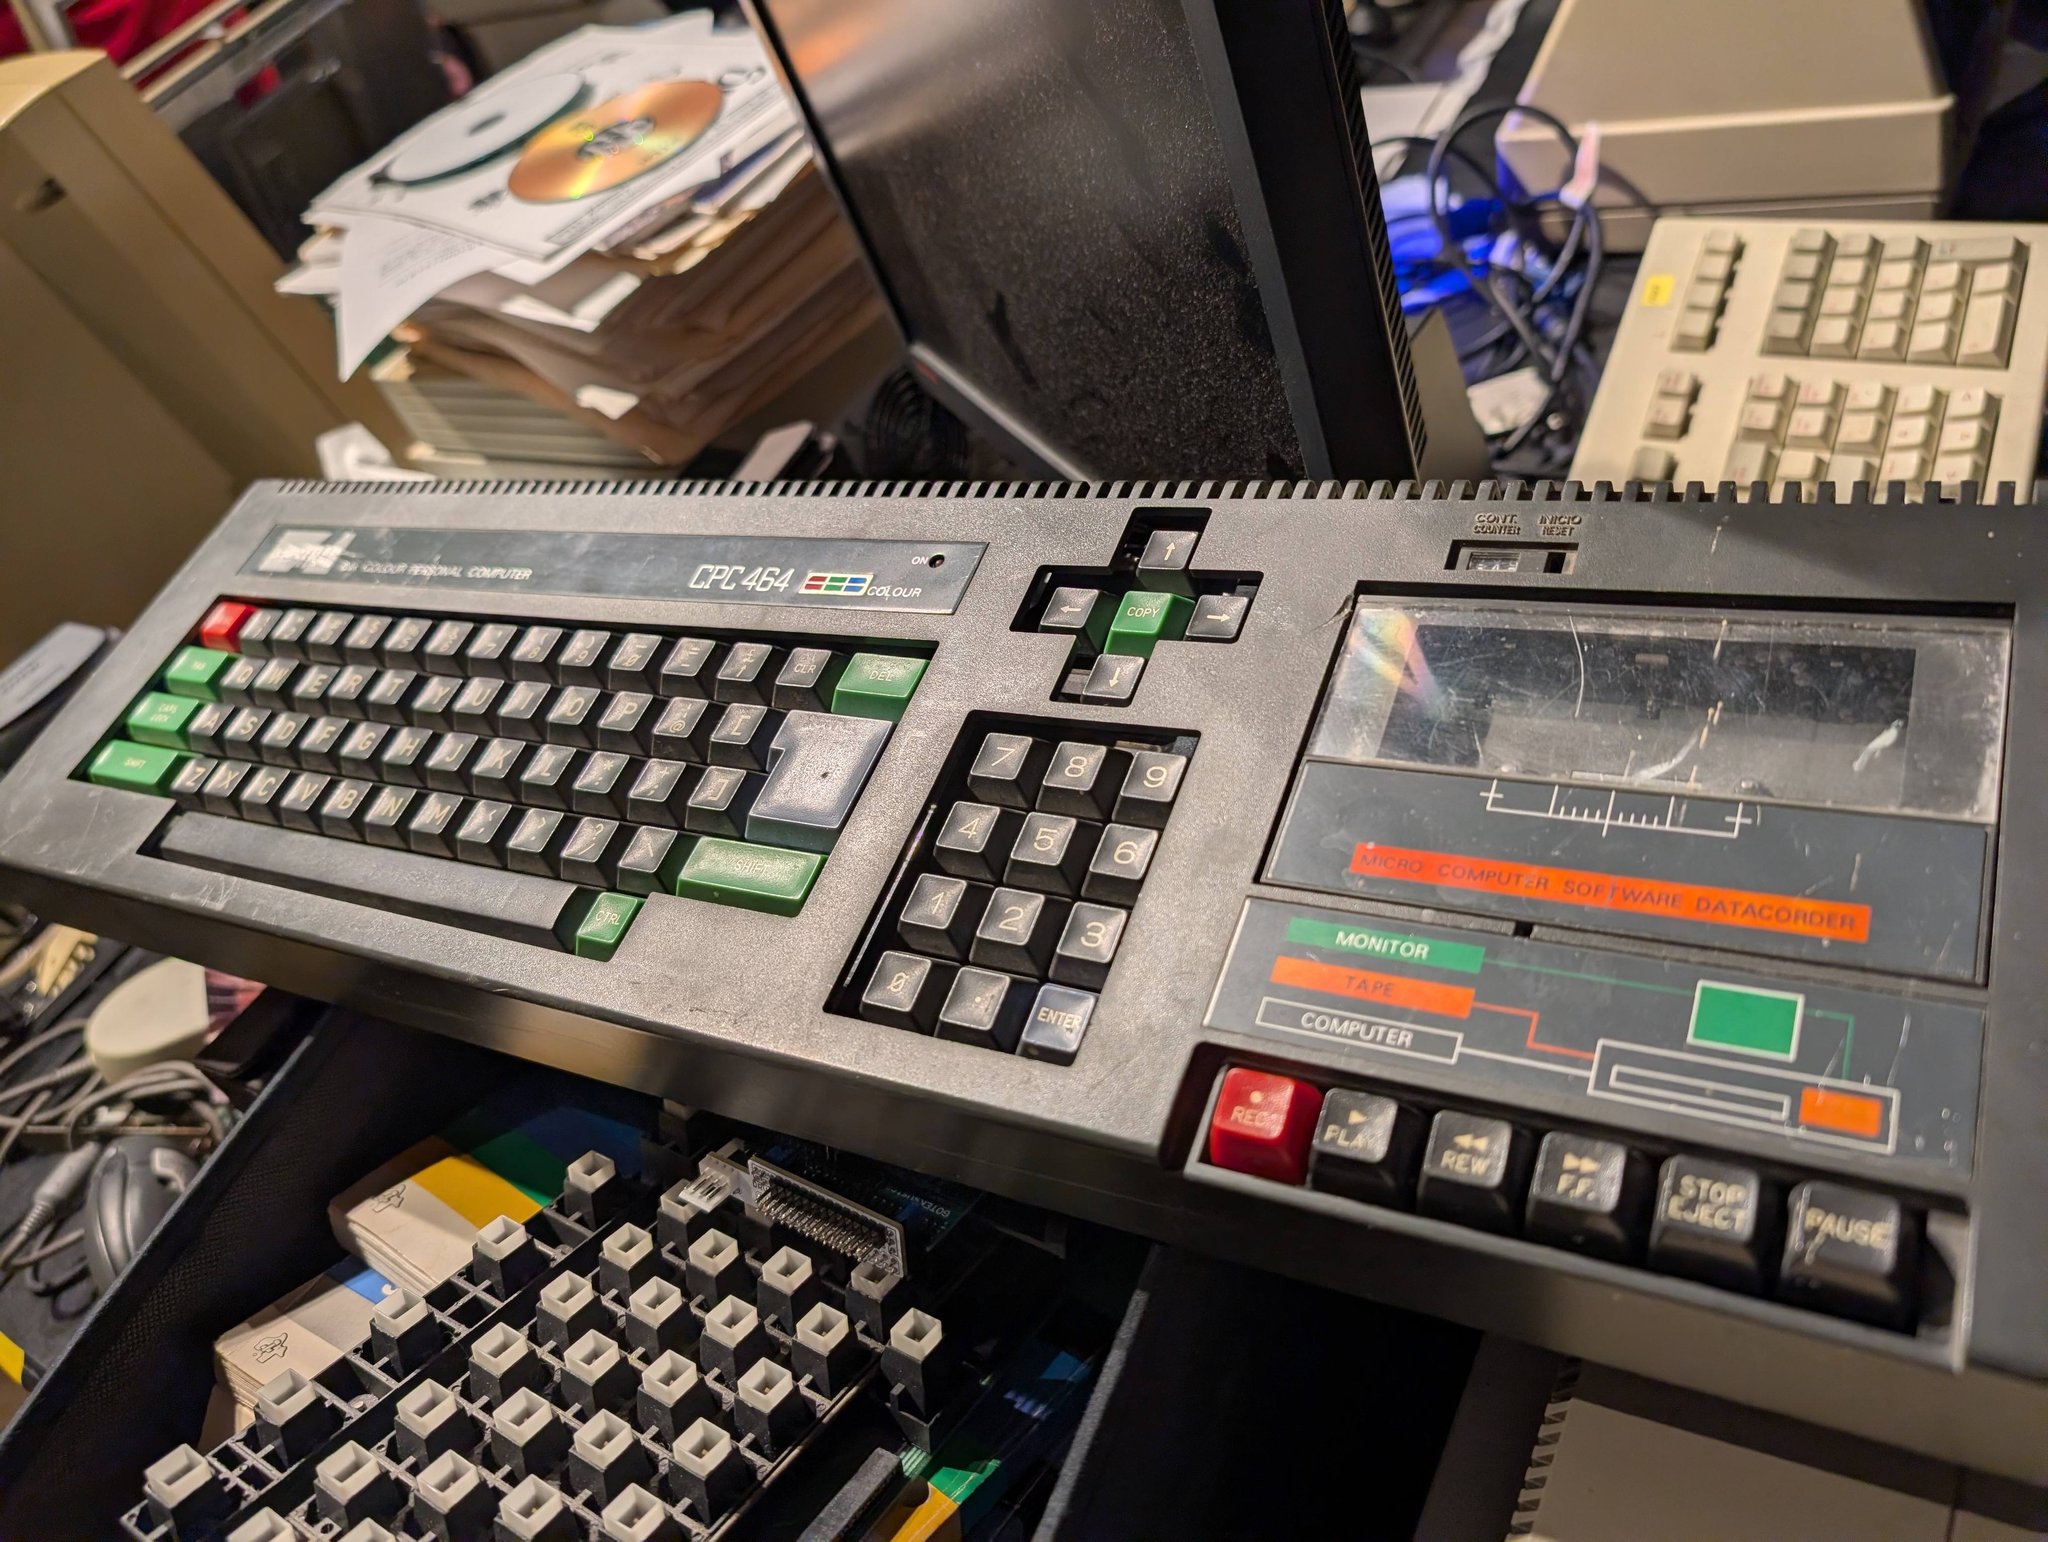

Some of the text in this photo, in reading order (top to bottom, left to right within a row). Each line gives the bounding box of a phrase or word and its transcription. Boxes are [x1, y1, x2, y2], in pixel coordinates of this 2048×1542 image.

[1473, 524, 1521, 535] COUNTER
[1538, 513, 1583, 526] INICIO
[1542, 525, 1576, 537] RESET
[911, 556, 929, 565] ON
[467, 565, 534, 581] COMPUTER
[688, 563, 922, 598] CPC 464 COLOUR
[1126, 606, 1160, 618] COPY
[575, 649, 589, 663] 9
[263, 665, 290, 685] W
[794, 663, 817, 675] CLR
[868, 669, 894, 682] DEL
[307, 673, 329, 693] E
[344, 673, 363, 694] R
[386, 677, 405, 698] T
[432, 686, 451, 705] Y
[471, 688, 492, 708] U
[201, 711, 221, 730] A
[618, 701, 639, 719] P
[240, 715, 258, 735] S
[277, 720, 297, 741] D
[316, 725, 337, 744] F
[669, 719, 686, 734] @
[357, 731, 377, 751] G
[401, 737, 421, 758] H
[445, 743, 464, 763] J
[491, 748, 512, 770] K
[990, 746, 1016, 767] 7
[186, 766, 206, 787] Z
[540, 755, 556, 777] L
[1064, 755, 1088, 778] 8
[1142, 765, 1168, 788] 9
[217, 769, 240, 790] X
[257, 776, 276, 798] C
[298, 782, 319, 802] V
[337, 789, 359, 810] B
[380, 796, 405, 818] N
[425, 804, 452, 826] M
[957, 817, 980, 839] 4
[1033, 827, 1058, 852] 5
[1113, 840, 1140, 865] 6
[734, 859, 771, 876] SHIFT
[1360, 853, 1856, 931] MICRO COMPUTER SOFTWARE DATACORDER
[931, 891, 945, 915] 1
[595, 910, 621, 926] CTRL
[998, 906, 1025, 932] 2
[1080, 921, 1107, 949] 3
[1334, 930, 1430, 960] MONITOR
[1345, 974, 1397, 998] TAPE
[1036, 1006, 1084, 1030] ENTER
[1299, 1010, 1414, 1048] COMPUTER
[1439, 1149, 1491, 1176] REW
[1679, 1174, 1747, 1206] STOP
[1667, 1194, 1746, 1233] EJECT
[1804, 1206, 1893, 1249] PAUSE
